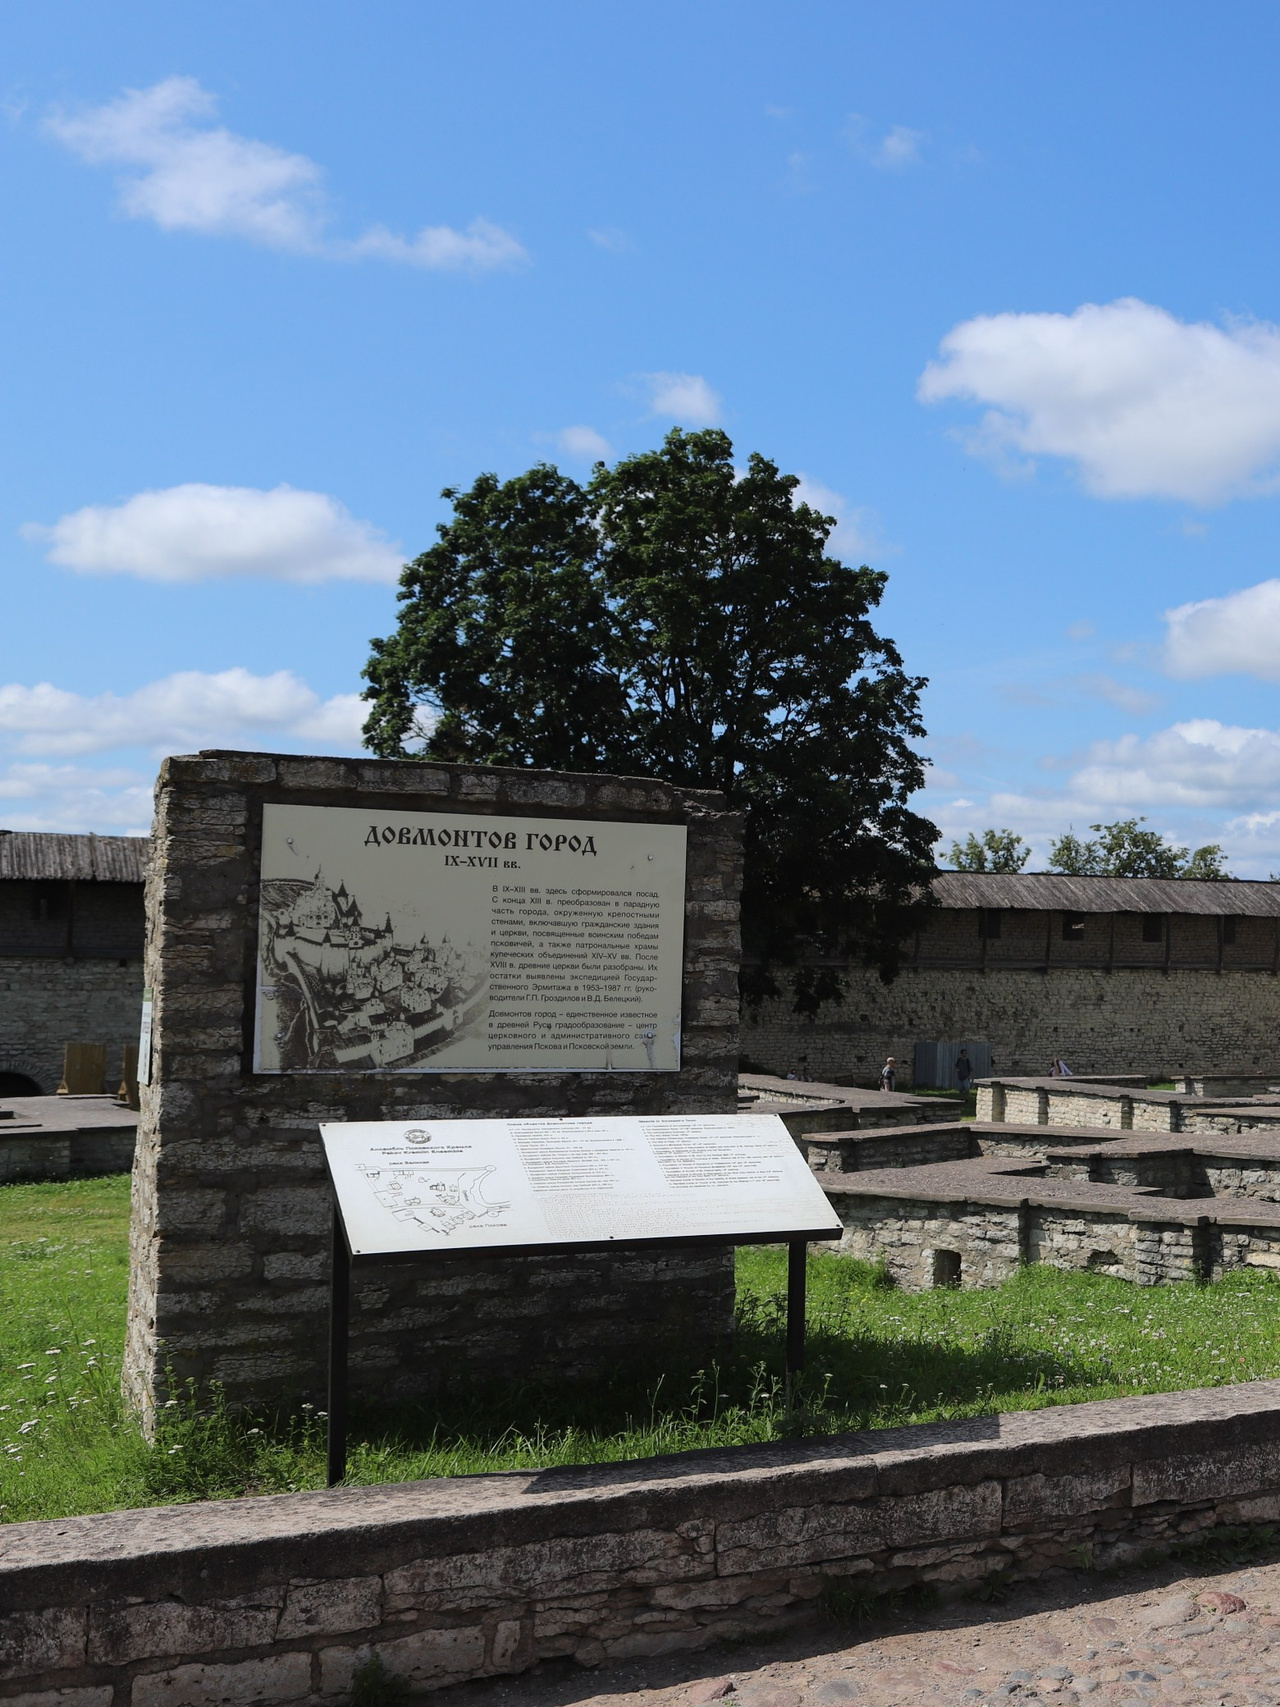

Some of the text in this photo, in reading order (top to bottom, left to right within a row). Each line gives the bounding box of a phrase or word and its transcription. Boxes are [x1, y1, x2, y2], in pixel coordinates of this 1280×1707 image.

[364, 825, 598, 856] ДОВМОНТОВ ГОРОД
[503, 860, 522, 869] вв.
[571, 888, 631, 897] сформировался
[557, 898, 610, 907] преобразован
[602, 963, 645, 971] разобраны.
[540, 994, 580, 1002] Гроздилов
[587, 994, 602, 1002] В.Д.
[489, 1010, 531, 1018] Довмонтов
[634, 1031, 657, 1040] сам-
